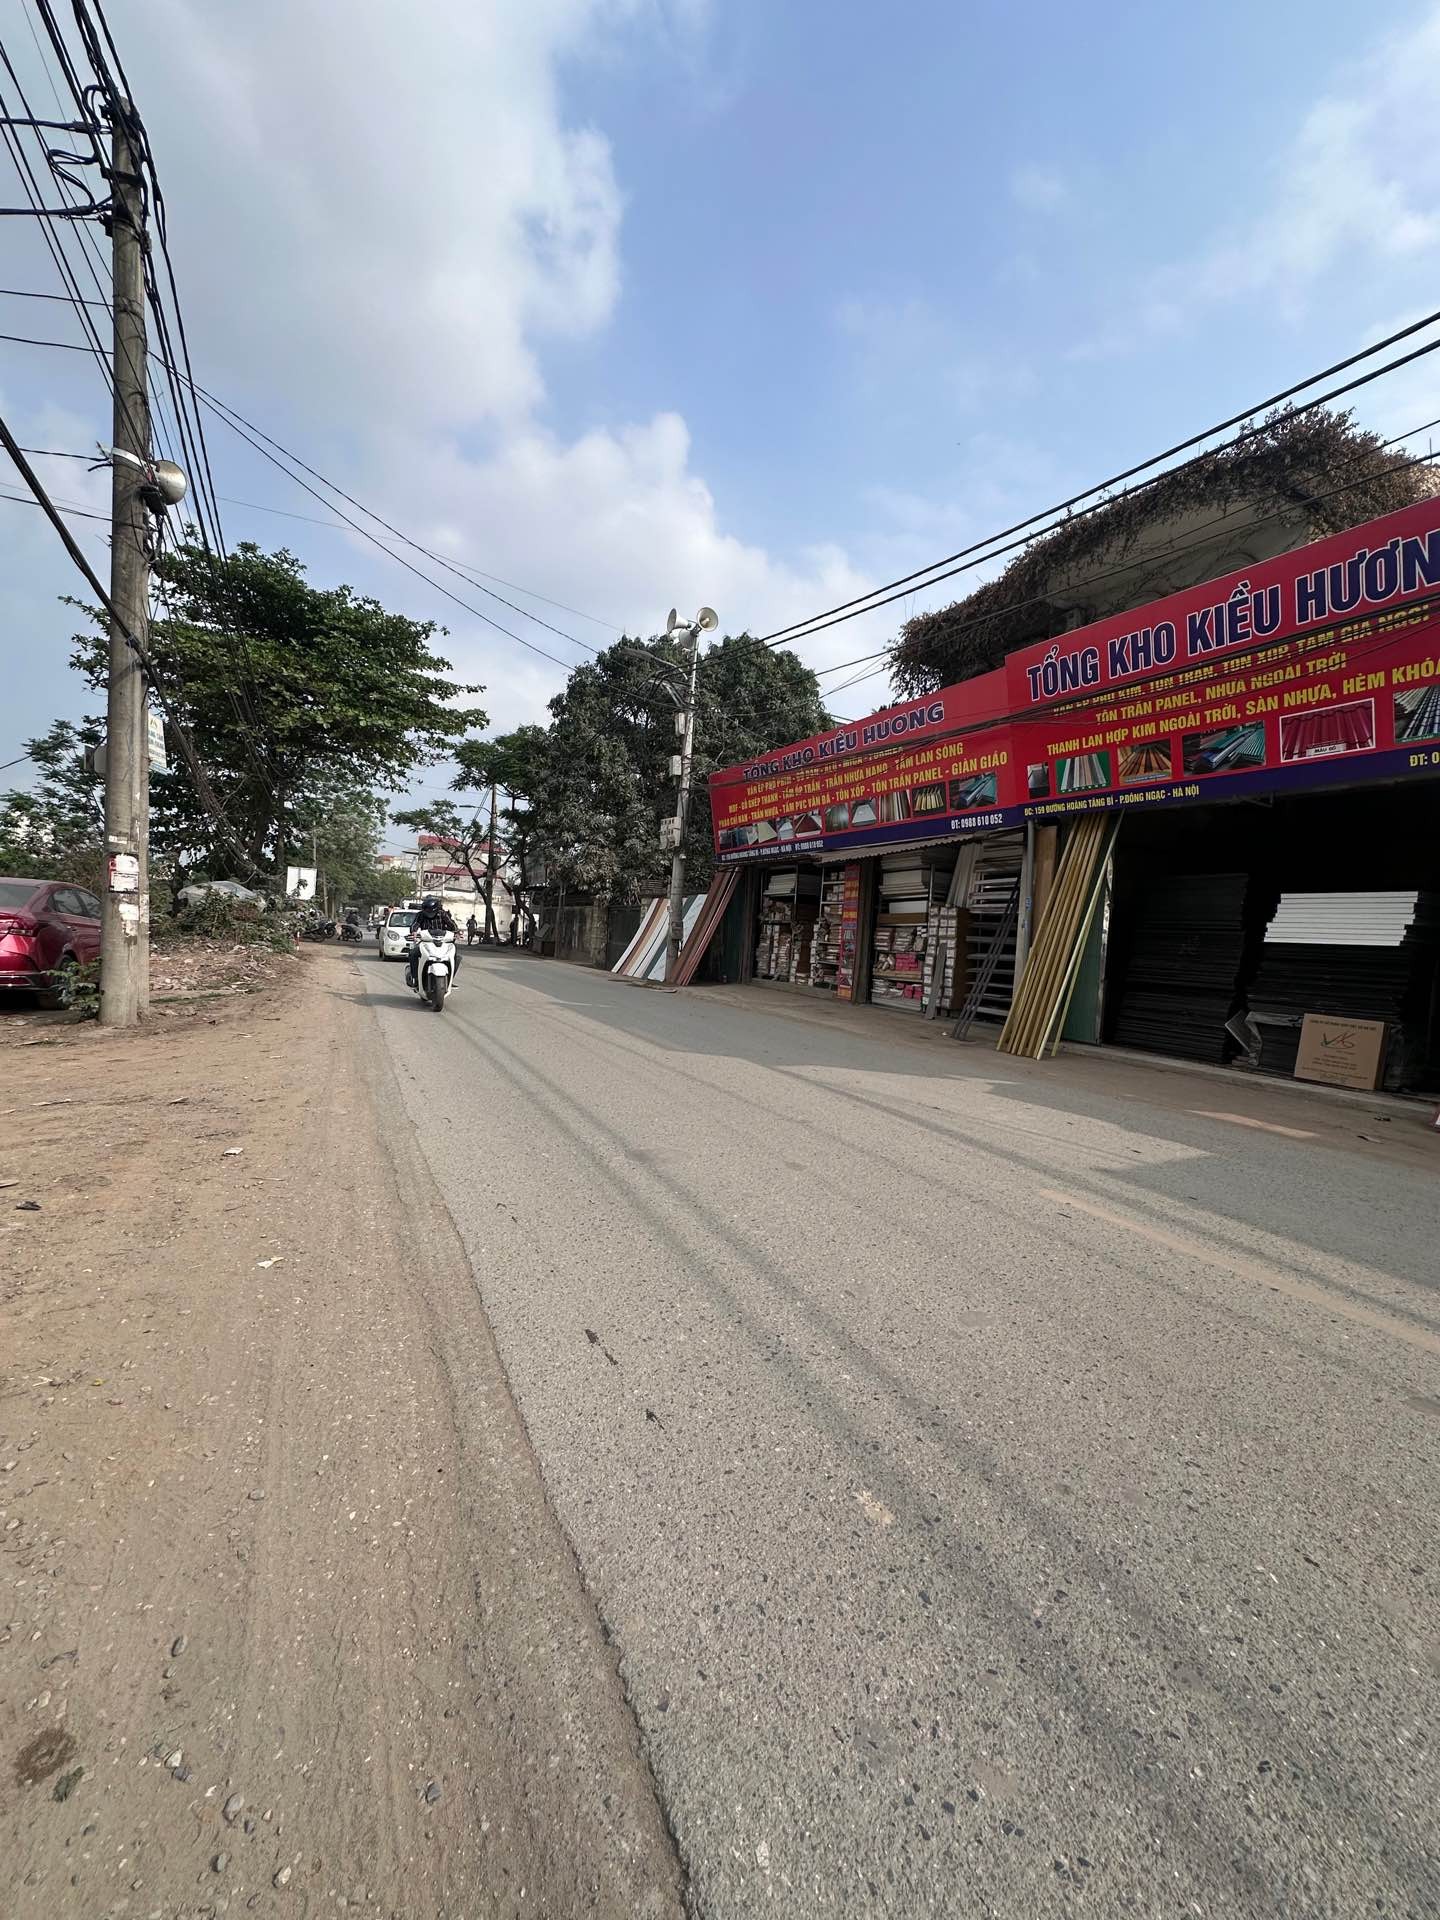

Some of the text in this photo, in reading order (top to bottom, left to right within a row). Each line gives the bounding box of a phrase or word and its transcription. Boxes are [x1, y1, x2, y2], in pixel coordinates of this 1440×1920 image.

[1026, 644, 1100, 701] TỔNG
[1107, 622, 1176, 679] KHO
[1187, 580, 1282, 657] KIỀU
[1046, 738, 1079, 756] THANH
[1082, 732, 1103, 748] LAN
[1106, 728, 1128, 745] HỢP
[1132, 723, 1156, 739] KIM
[1246, 696, 1279, 715] SÀN
[1283, 684, 1336, 708] NHỰA,
[913, 768, 944, 787] PANEL
[980, 750, 1008, 770] GIÁO
[1409, 753, 1428, 767] ĐT:
[1034, 805, 1045, 815] 159
[1145, 789, 1166, 802] NGẠC
[1185, 784, 1200, 798] NỘI
[989, 813, 1003, 826] 052
